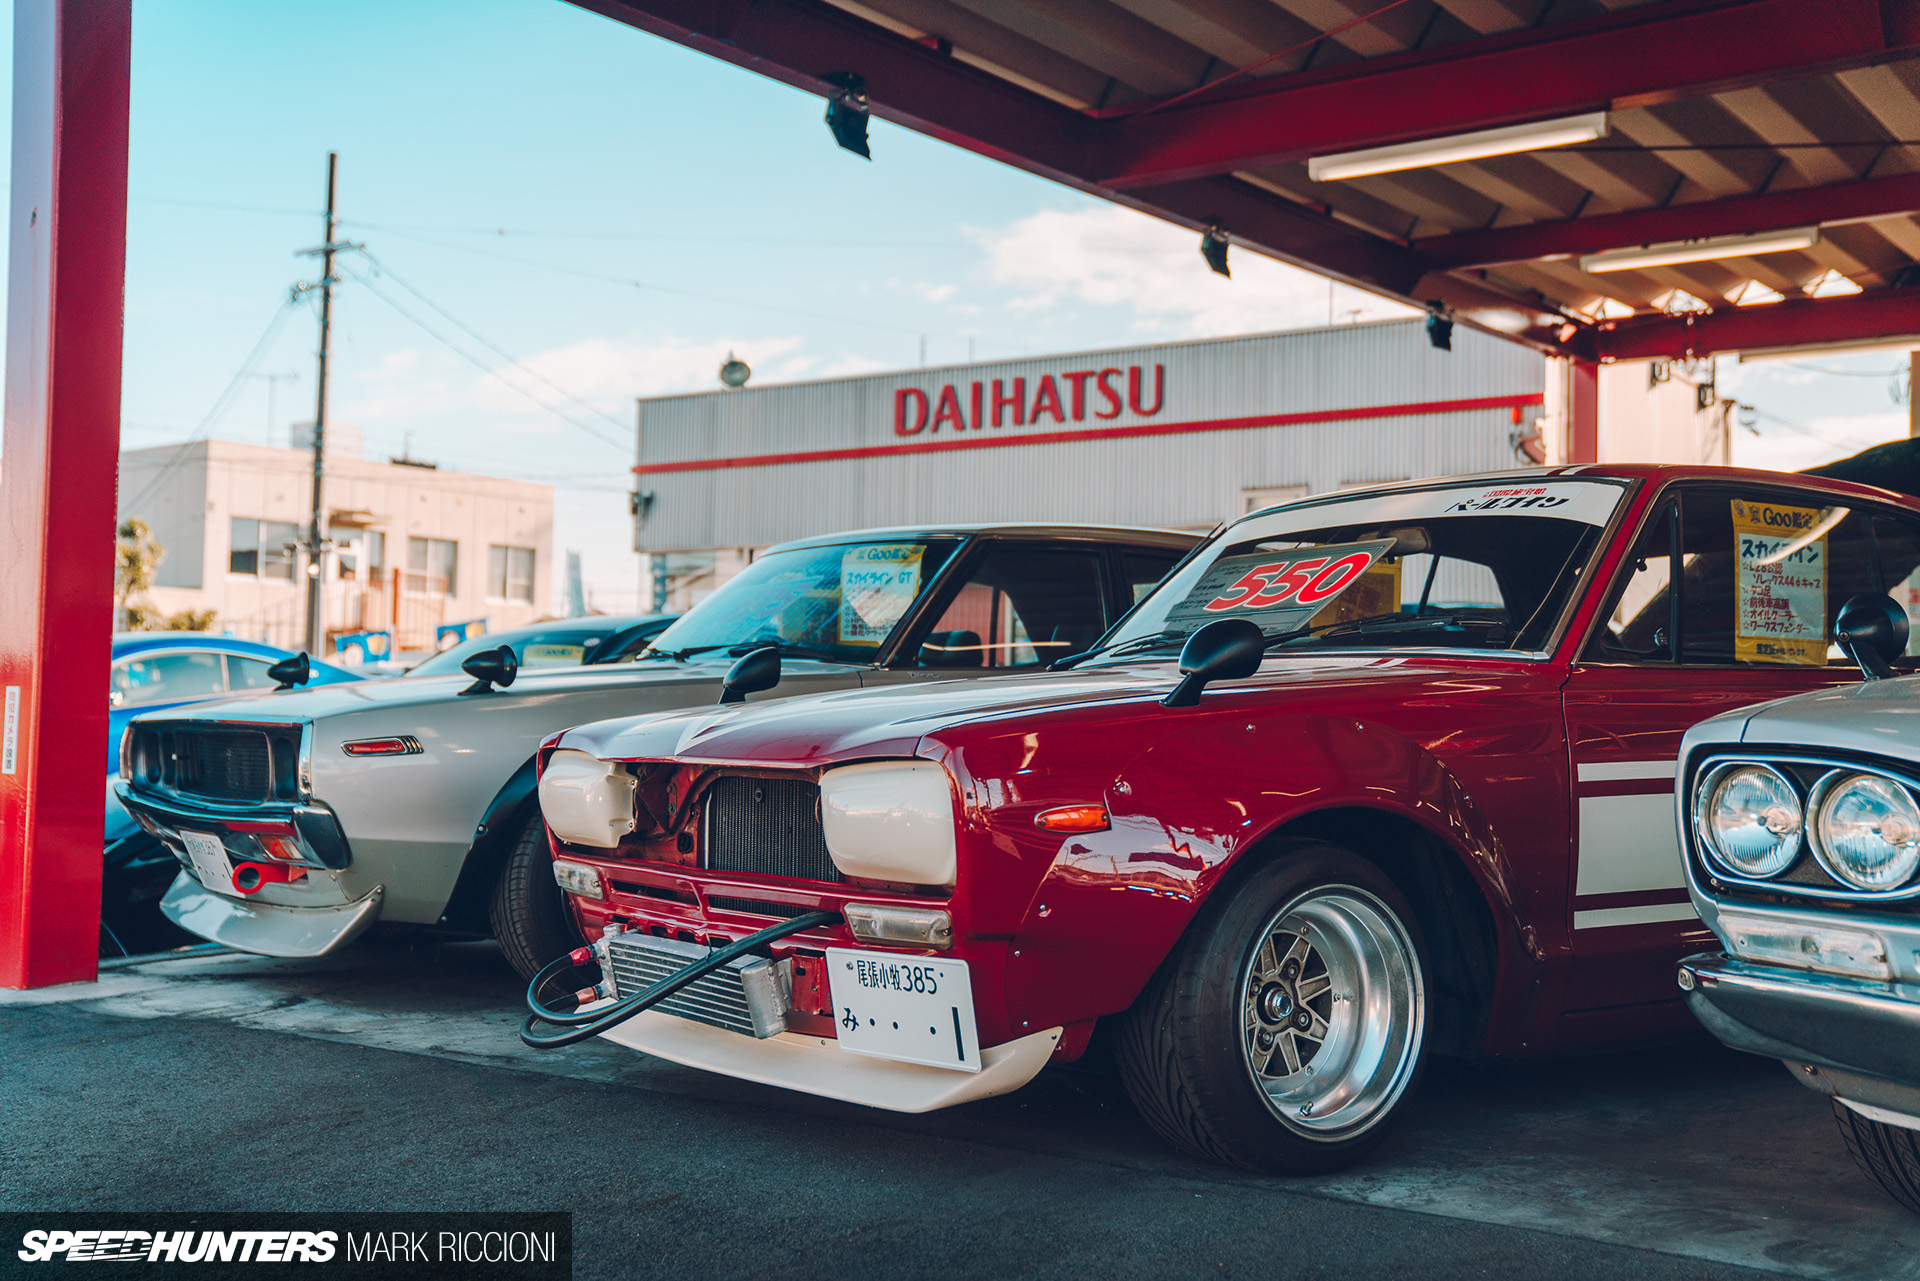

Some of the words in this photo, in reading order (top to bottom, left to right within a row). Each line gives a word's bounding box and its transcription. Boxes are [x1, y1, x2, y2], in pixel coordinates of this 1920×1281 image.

[894, 364, 1164, 436] DAIHATSU
[1203, 552, 1373, 612] 550
[842, 1007, 860, 1032] み
